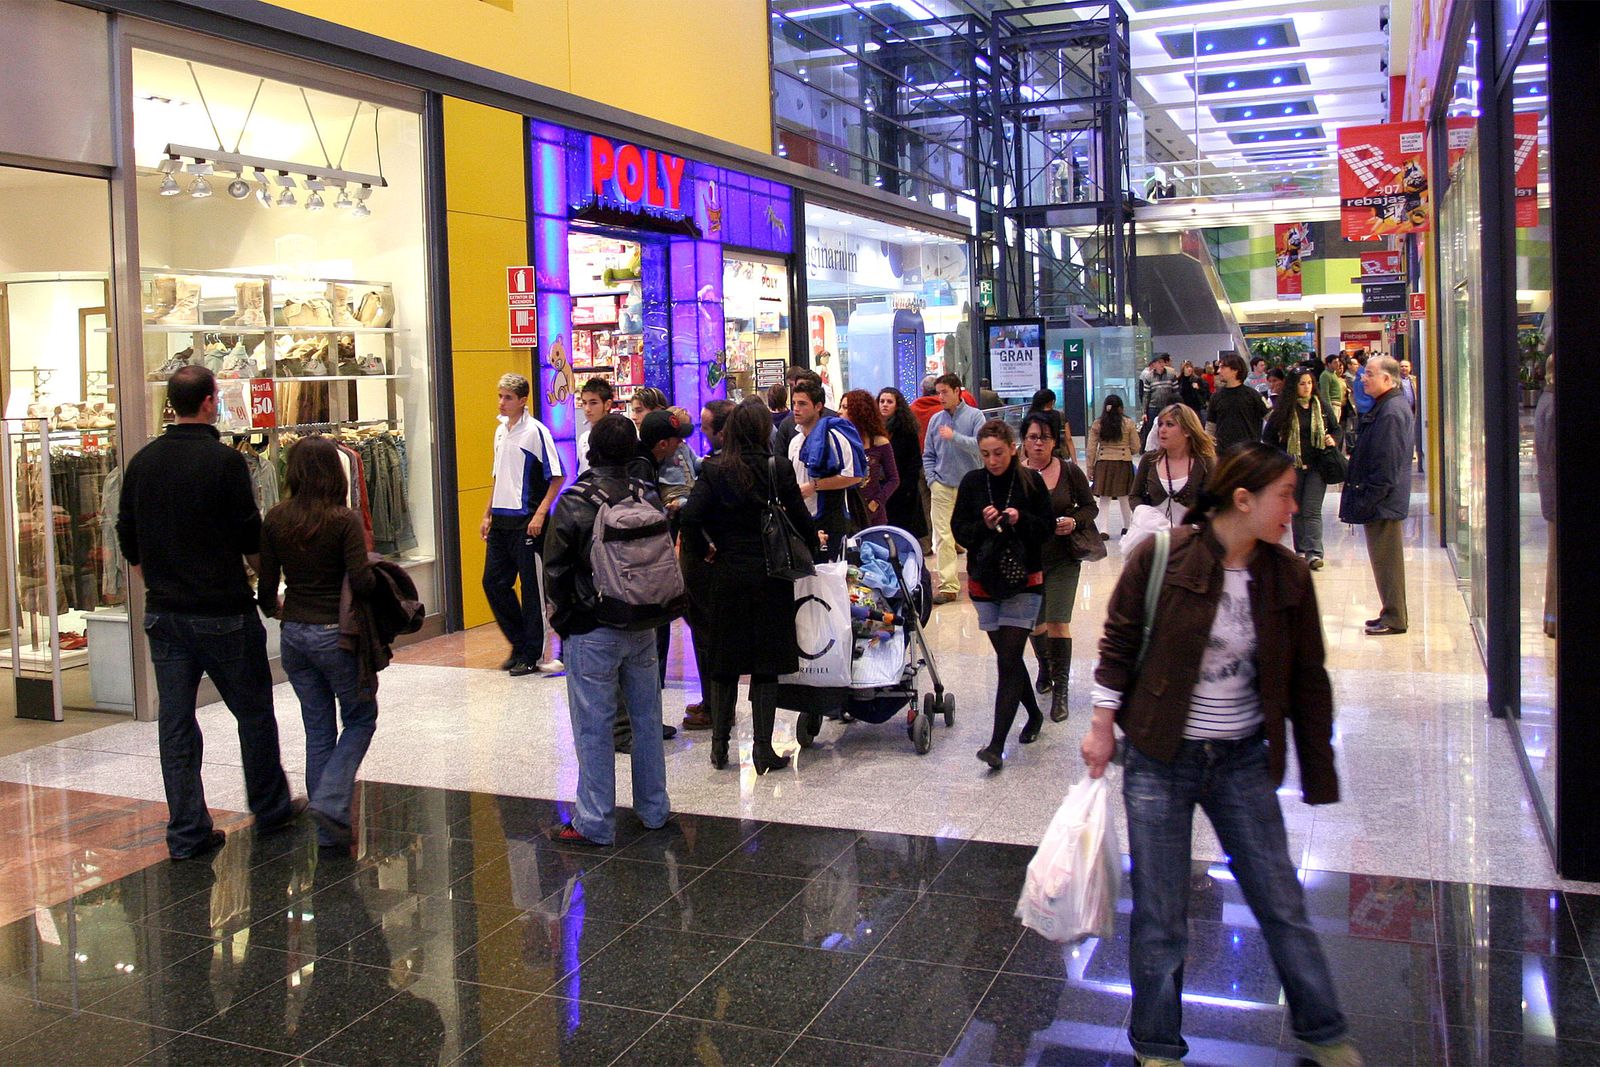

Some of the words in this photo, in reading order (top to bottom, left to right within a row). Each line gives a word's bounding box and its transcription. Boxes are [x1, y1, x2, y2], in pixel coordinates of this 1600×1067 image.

[590, 134, 686, 211] POLY
[1384, 184, 1401, 195] 07
[1347, 195, 1407, 207] rebajas
[1000, 349, 1033, 362] GRAN
[1071, 360, 1078, 371] P
